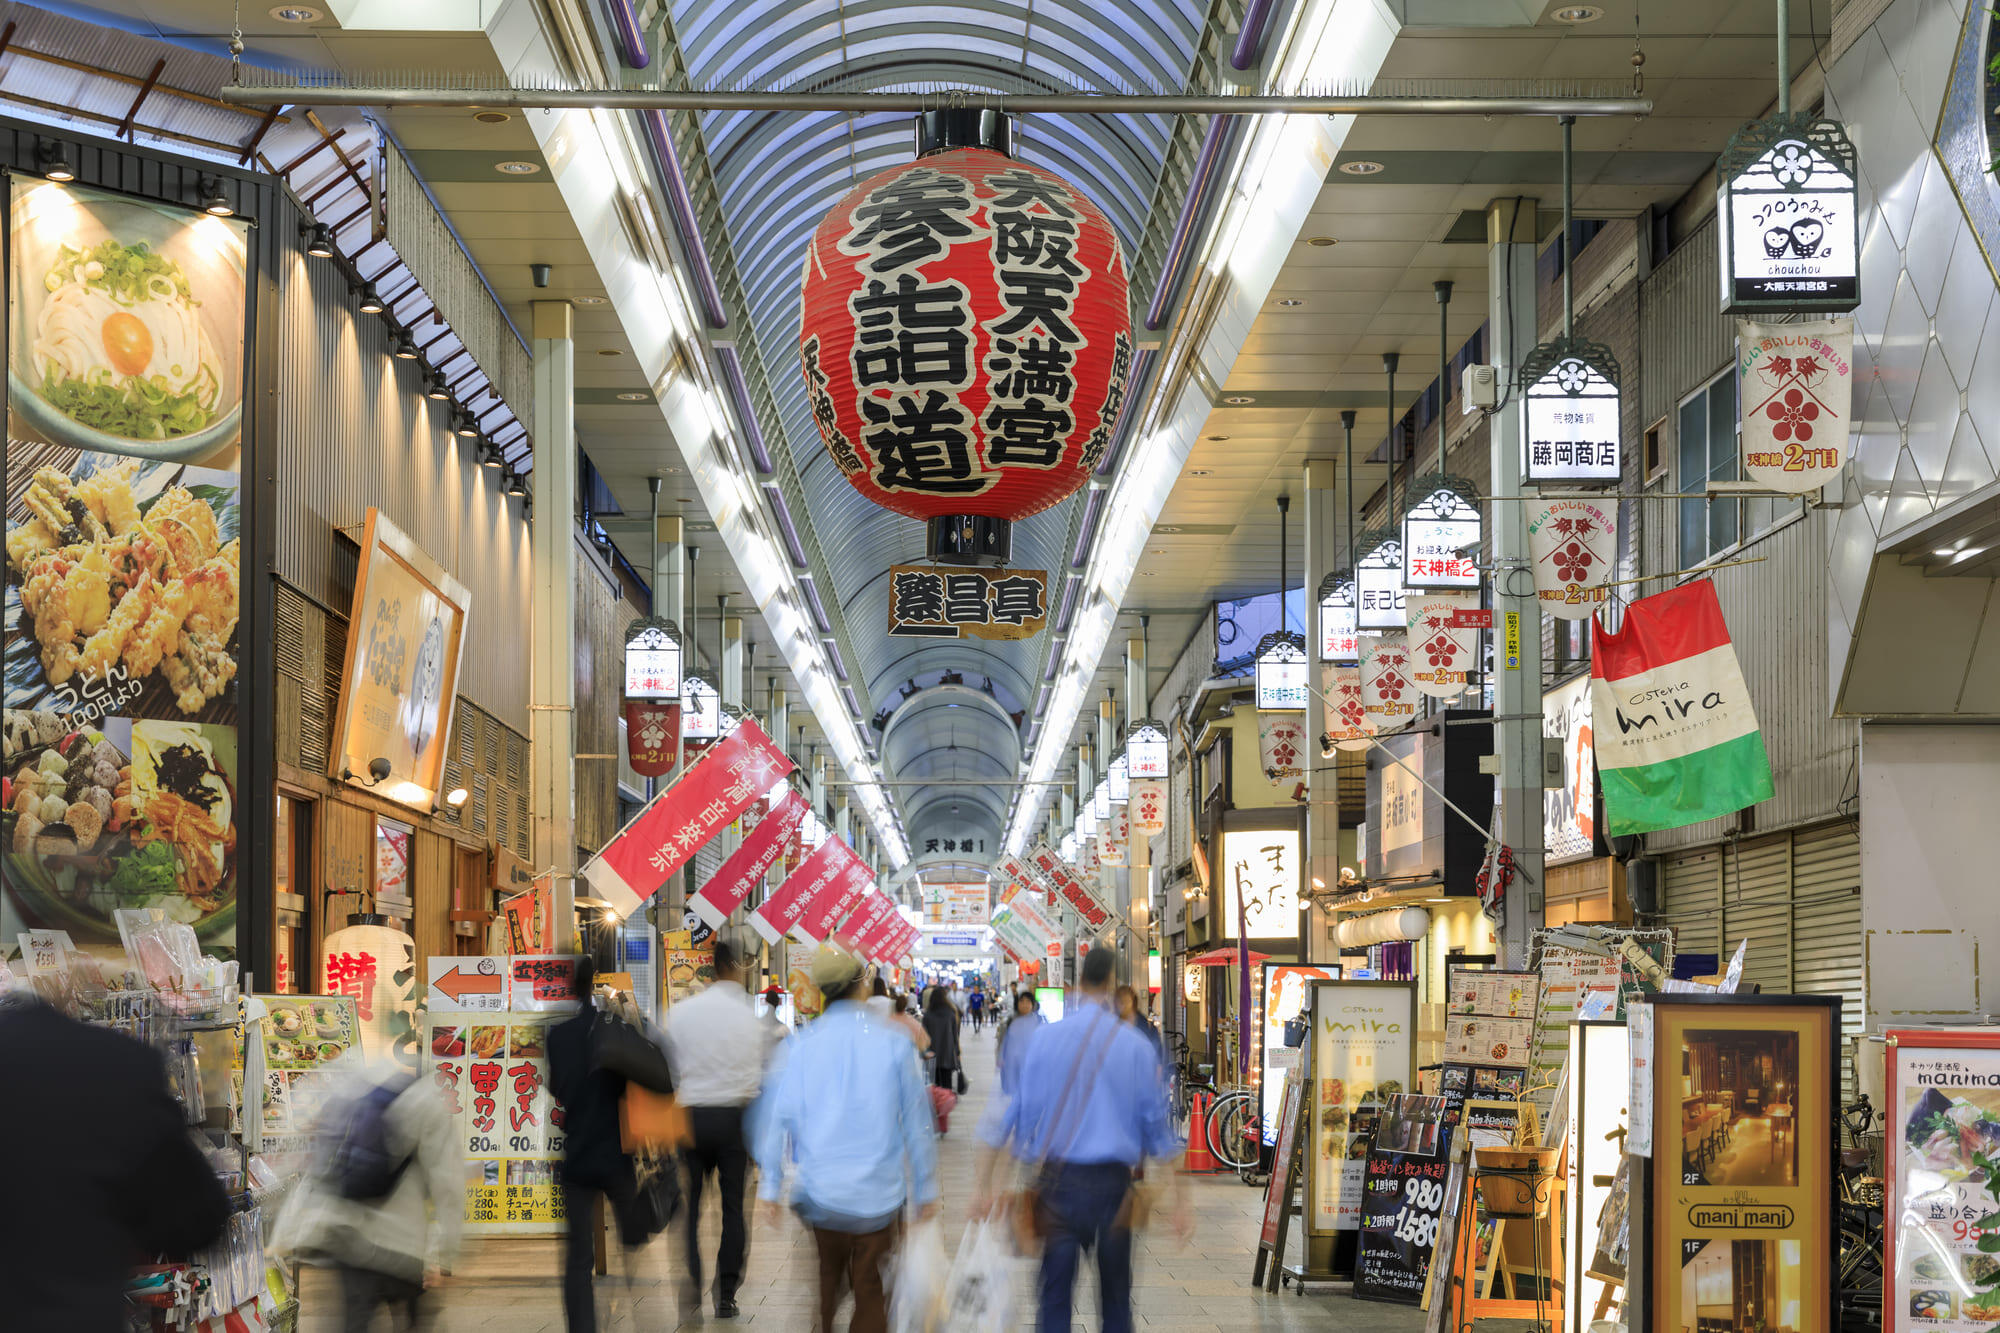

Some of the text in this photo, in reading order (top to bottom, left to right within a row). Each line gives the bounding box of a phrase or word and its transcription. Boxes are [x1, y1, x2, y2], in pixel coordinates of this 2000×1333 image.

[1768, 264, 1821, 275] chouchou
[848, 172, 990, 492] 参詣道
[984, 171, 1087, 466] 大阪天満宮
[1533, 440, 1615, 466] 藤岡商店
[1747, 443, 1839, 473] 天神橋2丁目
[1412, 559, 1476, 577] 天神橋2
[894, 572, 1044, 626] 繁昌亭
[54, 660, 128, 713] うどん
[61, 680, 143, 732] 100円より
[1615, 691, 1727, 735] mira
[648, 752, 783, 873] 天満音楽祭
[729, 801, 807, 898] 天満音楽祭
[783, 847, 853, 920] 天満音楽祭
[470, 1061, 502, 1133] 串カツ
[1405, 1177, 1443, 1212] 980
[1683, 1173, 1699, 1184] 2F
[506, 1199, 549, 1209] チューハイ
[1394, 1206, 1438, 1247] 1580
[1684, 1242, 1700, 1253] 1F
